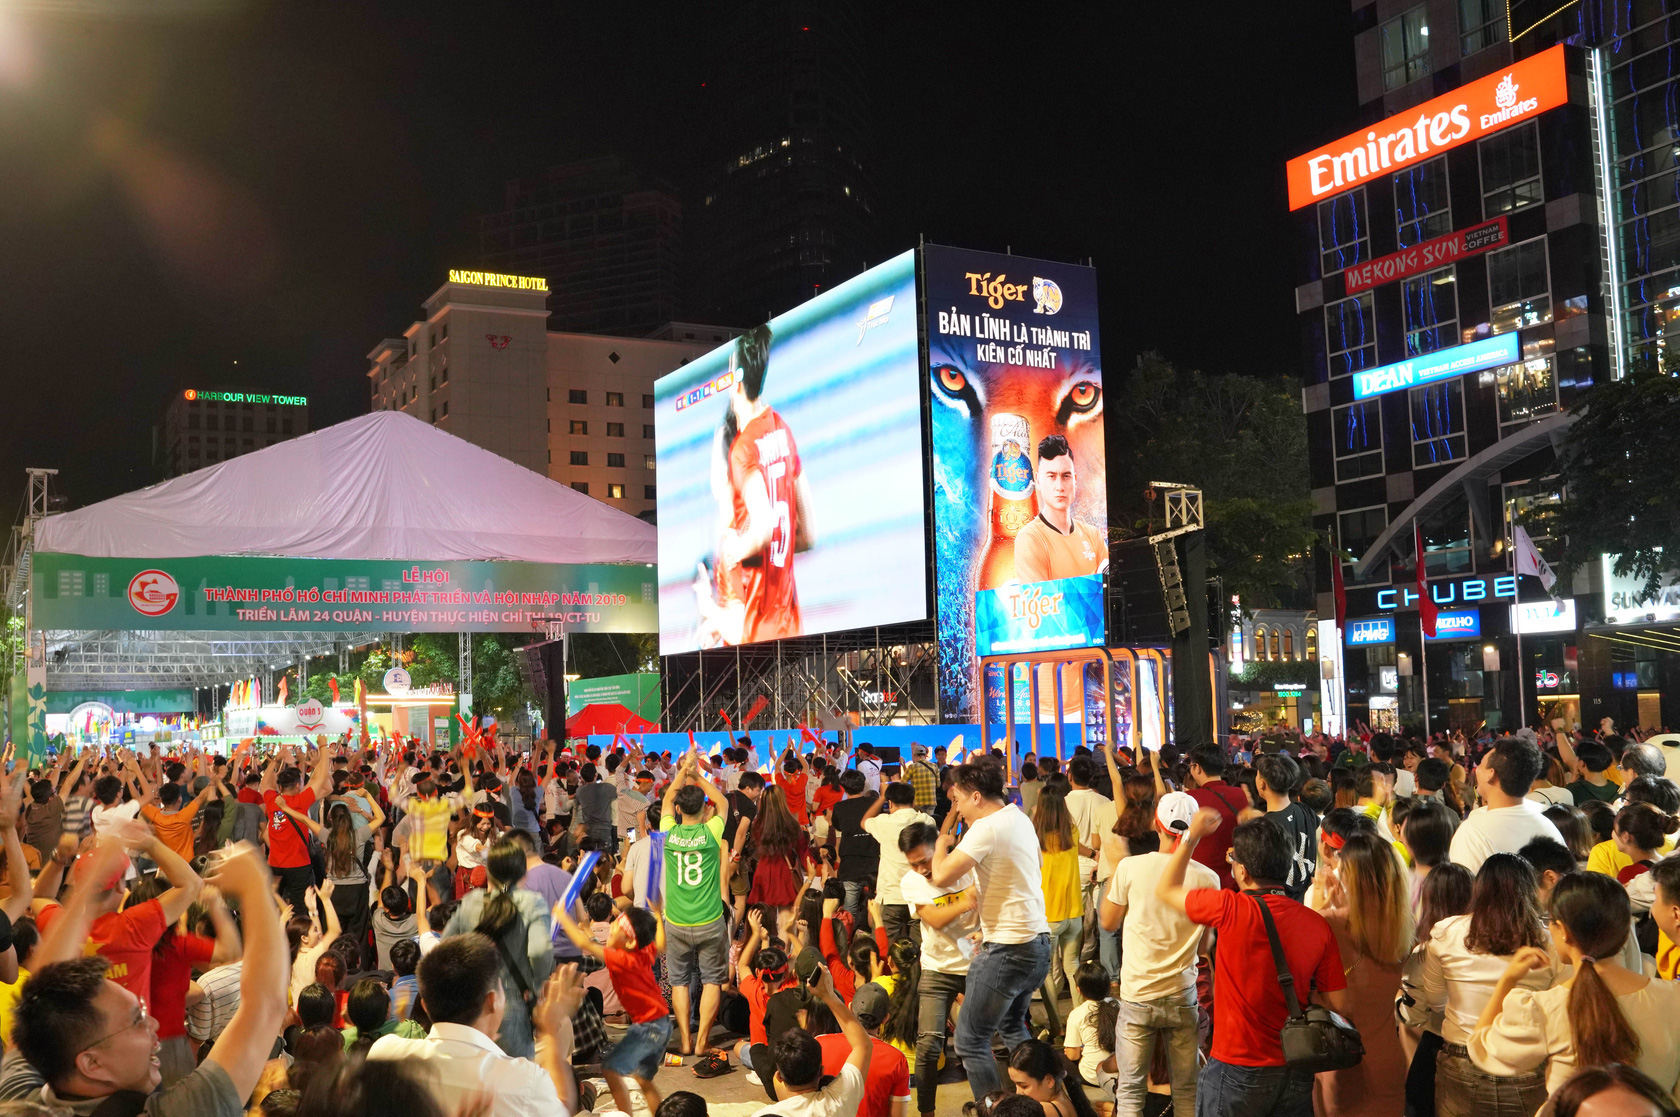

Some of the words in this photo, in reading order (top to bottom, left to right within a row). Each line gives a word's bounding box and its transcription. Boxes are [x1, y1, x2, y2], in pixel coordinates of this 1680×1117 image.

[1480, 97, 1538, 129] Emirates
[1307, 104, 1471, 196] Emirates
[1462, 231, 1504, 251] COFFEE
[1465, 225, 1499, 241] VIETNAM
[1348, 250, 1418, 288] MEKONG
[1423, 238, 1458, 266] SUN
[449, 269, 483, 285] SAIGON
[484, 273, 518, 288] PRINCE
[518, 276, 549, 291] HOTEL
[965, 272, 1028, 309] Tiger
[938, 306, 971, 337] BẢN
[975, 312, 1010, 342] LĨNH
[1014, 323, 1028, 344] LÀ
[1030, 326, 1070, 348] THÀNH
[1072, 330, 1091, 351] TRÌ
[977, 342, 1005, 364] KIÊN
[1008, 344, 1025, 366] CỐ
[1026, 347, 1057, 369] NHẤT
[1418, 363, 1450, 377] VIETNAM
[1451, 356, 1475, 370] ACCESS
[1476, 349, 1509, 363] AMERICA
[197, 391, 244, 402] HARBOUR
[246, 394, 270, 403] VIEW
[272, 395, 307, 406] TOWER
[996, 462, 1029, 483] Tiger
[402, 566, 420, 583] LỄ
[423, 569, 450, 586] HỘI
[204, 586, 258, 602] THÀNH
[262, 586, 294, 603] PHỐ
[296, 587, 320, 603] HỒ
[322, 588, 348, 604] CHÍ
[351, 591, 389, 604] MINH
[392, 589, 430, 605] PHÁT
[431, 588, 471, 605] TRIỂN
[473, 589, 492, 605] VÀ
[495, 590, 519, 607] HỘI
[522, 590, 559, 608] NHẬP
[562, 591, 593, 605] NĂM
[595, 594, 626, 606] 2019
[1009, 586, 1064, 629] Tiger
[236, 606, 277, 621] TRIỂN
[280, 607, 310, 622] LÃM
[313, 610, 330, 622] 24
[332, 608, 372, 624] QUẬN
[383, 610, 425, 625] HUYỆN
[430, 610, 472, 625] THỰC
[475, 610, 499, 625] HIỆN
[501, 609, 523, 623] CHỈ
[1352, 629, 1390, 642] KPMG
[673, 850, 703, 886] 18
